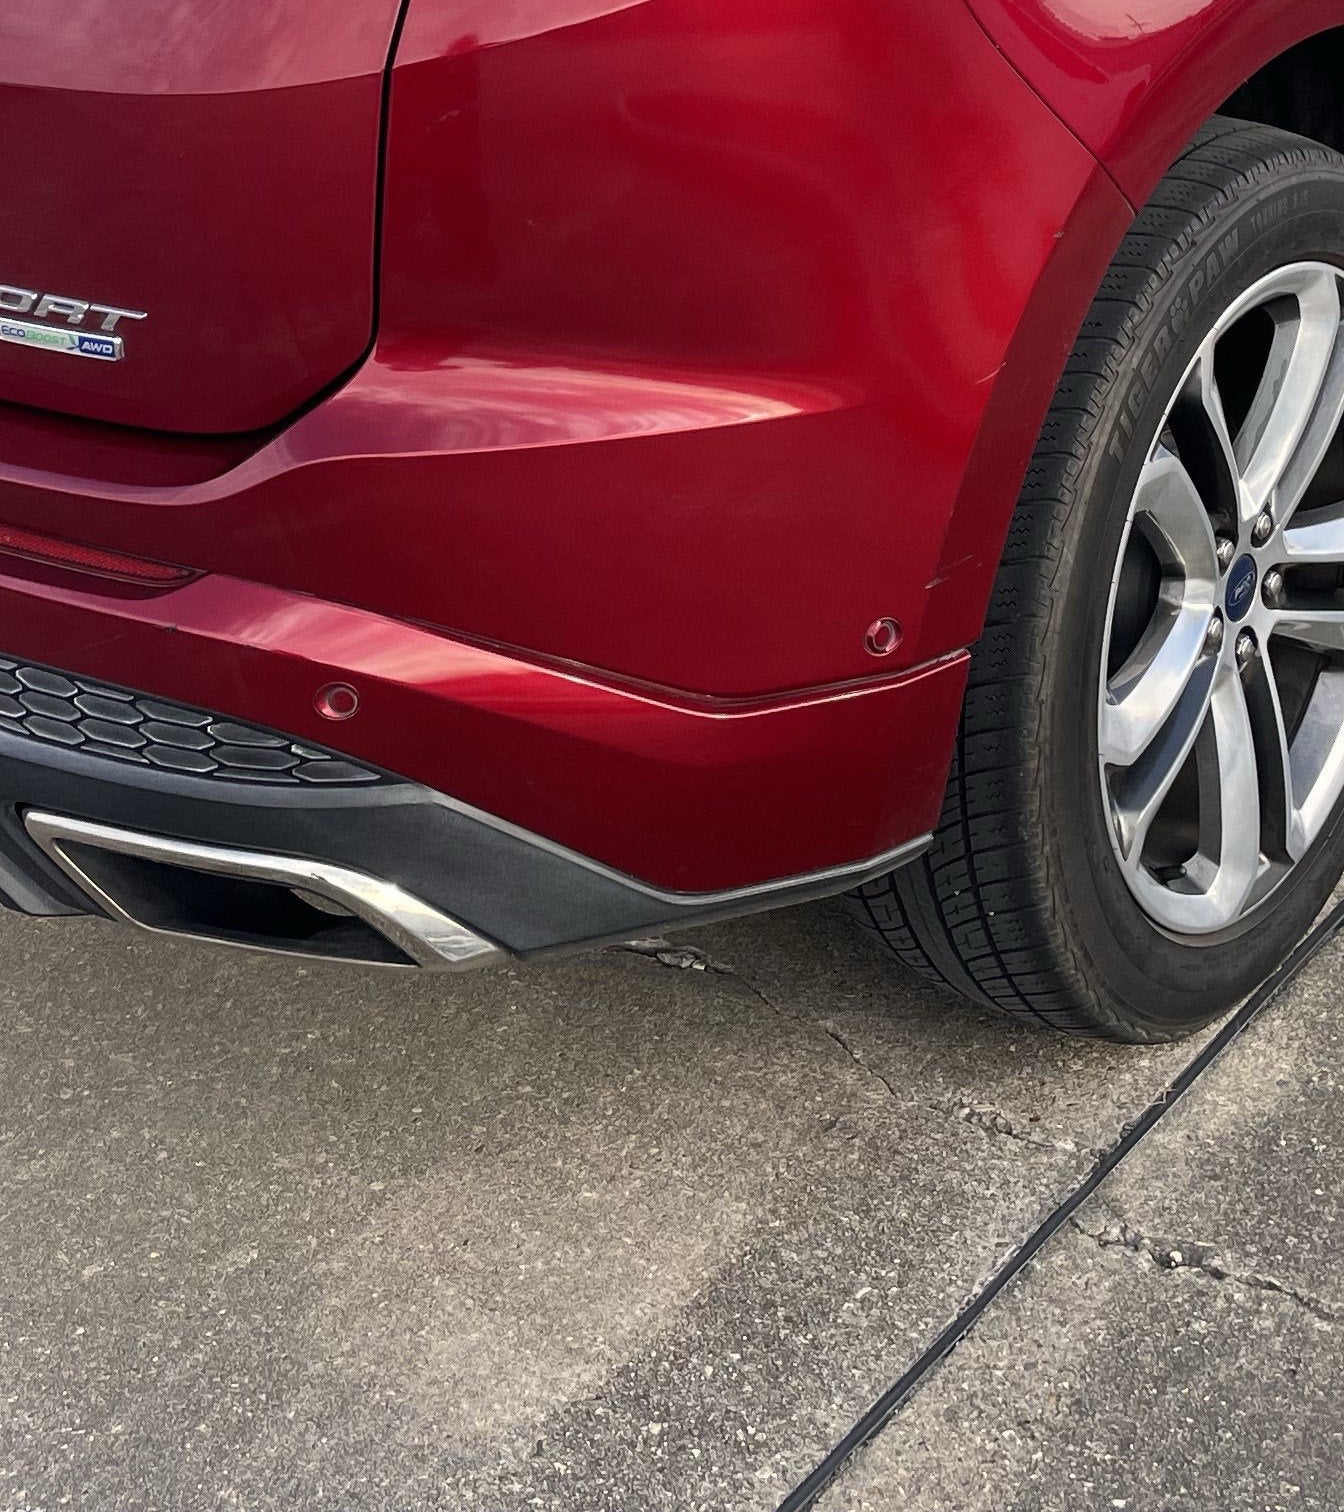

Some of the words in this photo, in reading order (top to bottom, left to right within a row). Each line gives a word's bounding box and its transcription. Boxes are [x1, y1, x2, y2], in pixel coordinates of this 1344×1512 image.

[81, 340, 113, 355] AWD
[1109, 325, 1172, 464] TIGER
[1188, 228, 1239, 307] PAW
